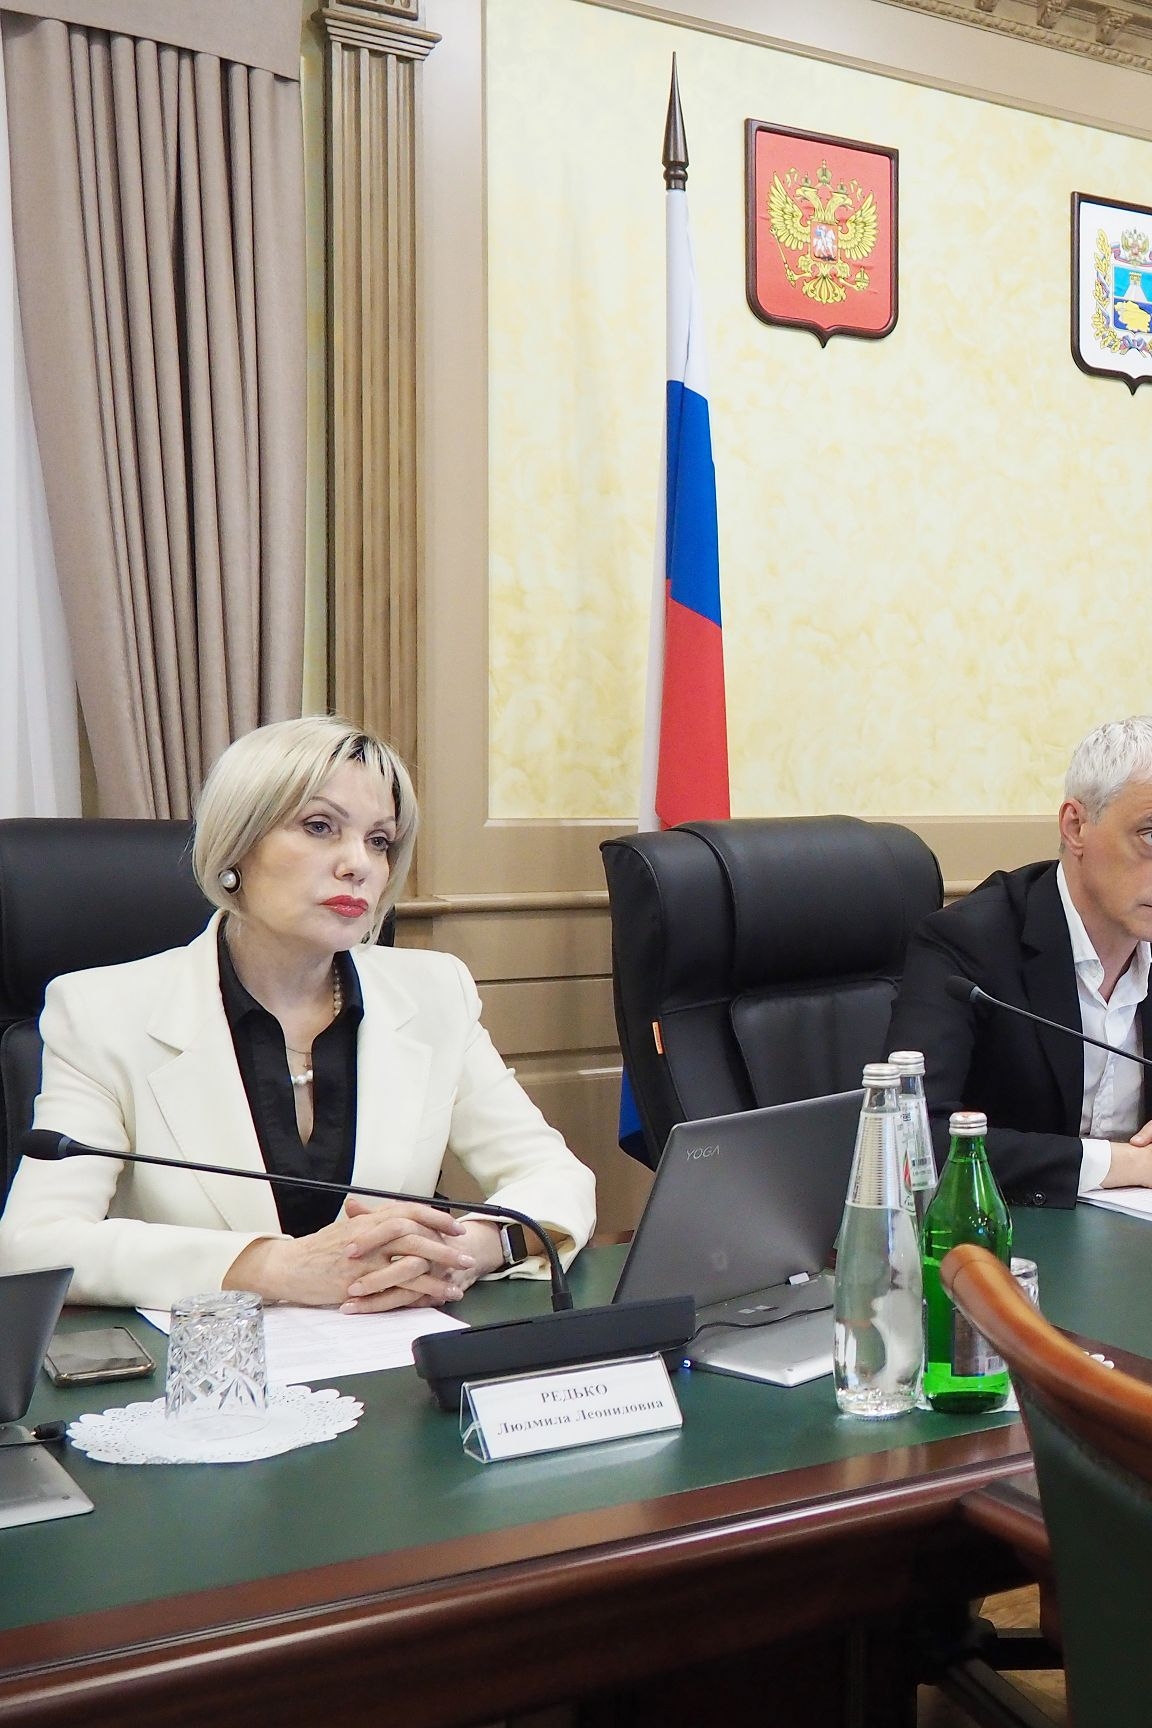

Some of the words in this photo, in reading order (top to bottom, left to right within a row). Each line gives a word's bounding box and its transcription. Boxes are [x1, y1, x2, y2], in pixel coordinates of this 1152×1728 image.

[686, 1144, 720, 1161] YOGA
[540, 1383, 609, 1404] РЕДЬКО
[497, 1415, 571, 1435] Людмила
[575, 1399, 664, 1422] Леонидовна
